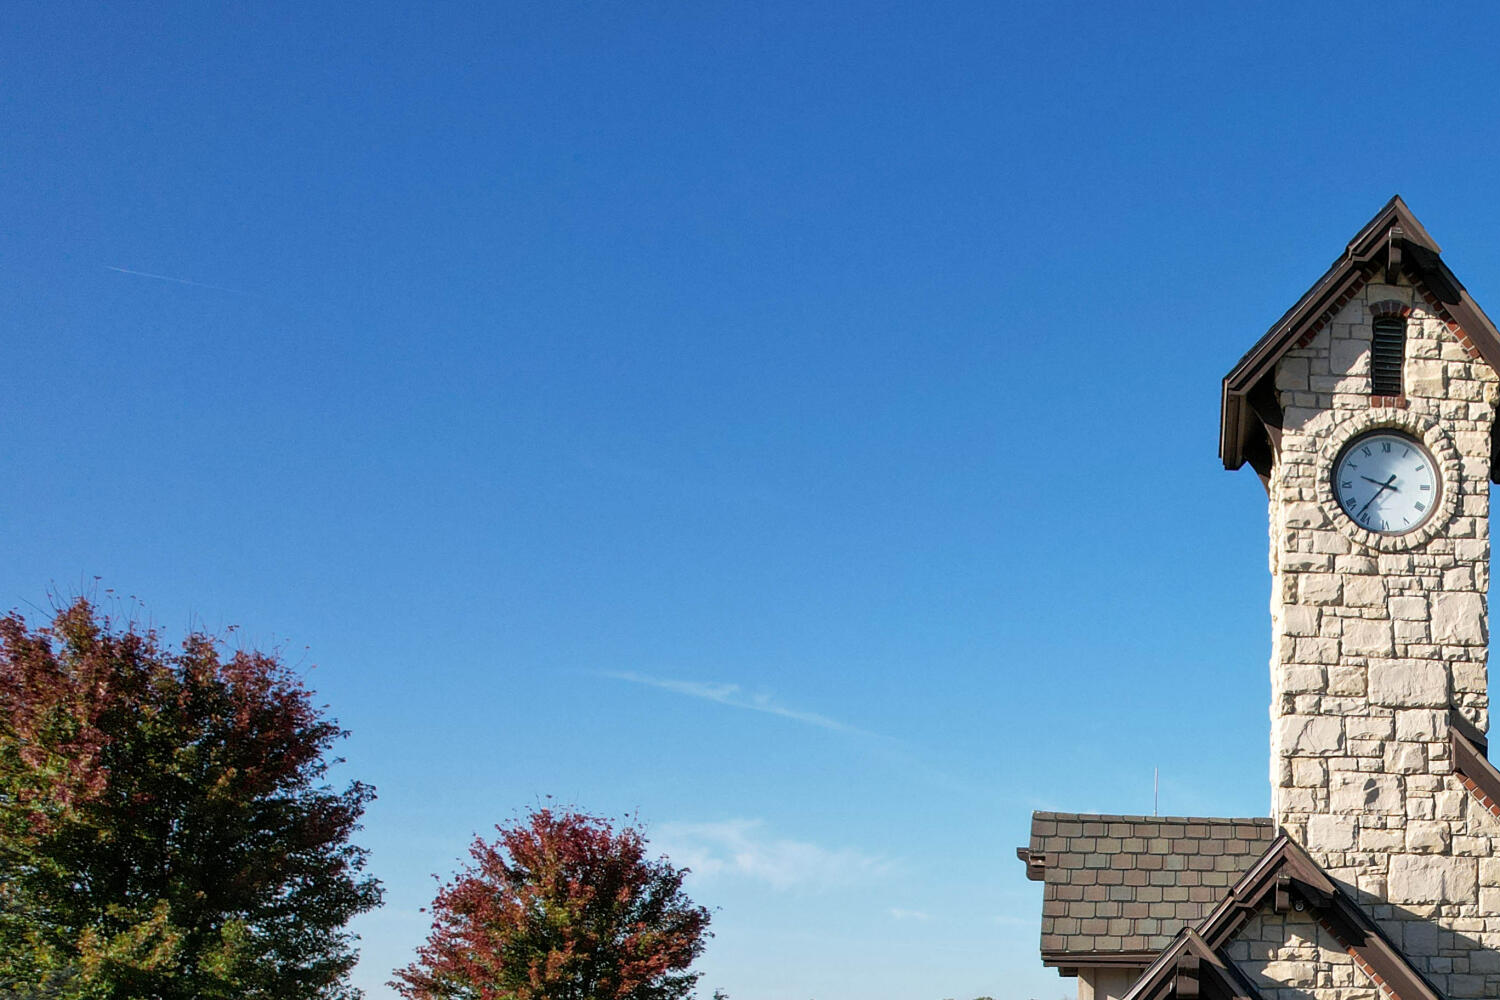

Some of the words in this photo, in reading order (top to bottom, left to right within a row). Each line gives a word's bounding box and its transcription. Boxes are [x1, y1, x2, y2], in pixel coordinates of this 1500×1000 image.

[1361, 446, 1372, 458] XI
[1382, 442, 1391, 453] XII
[1346, 459, 1358, 471] X
